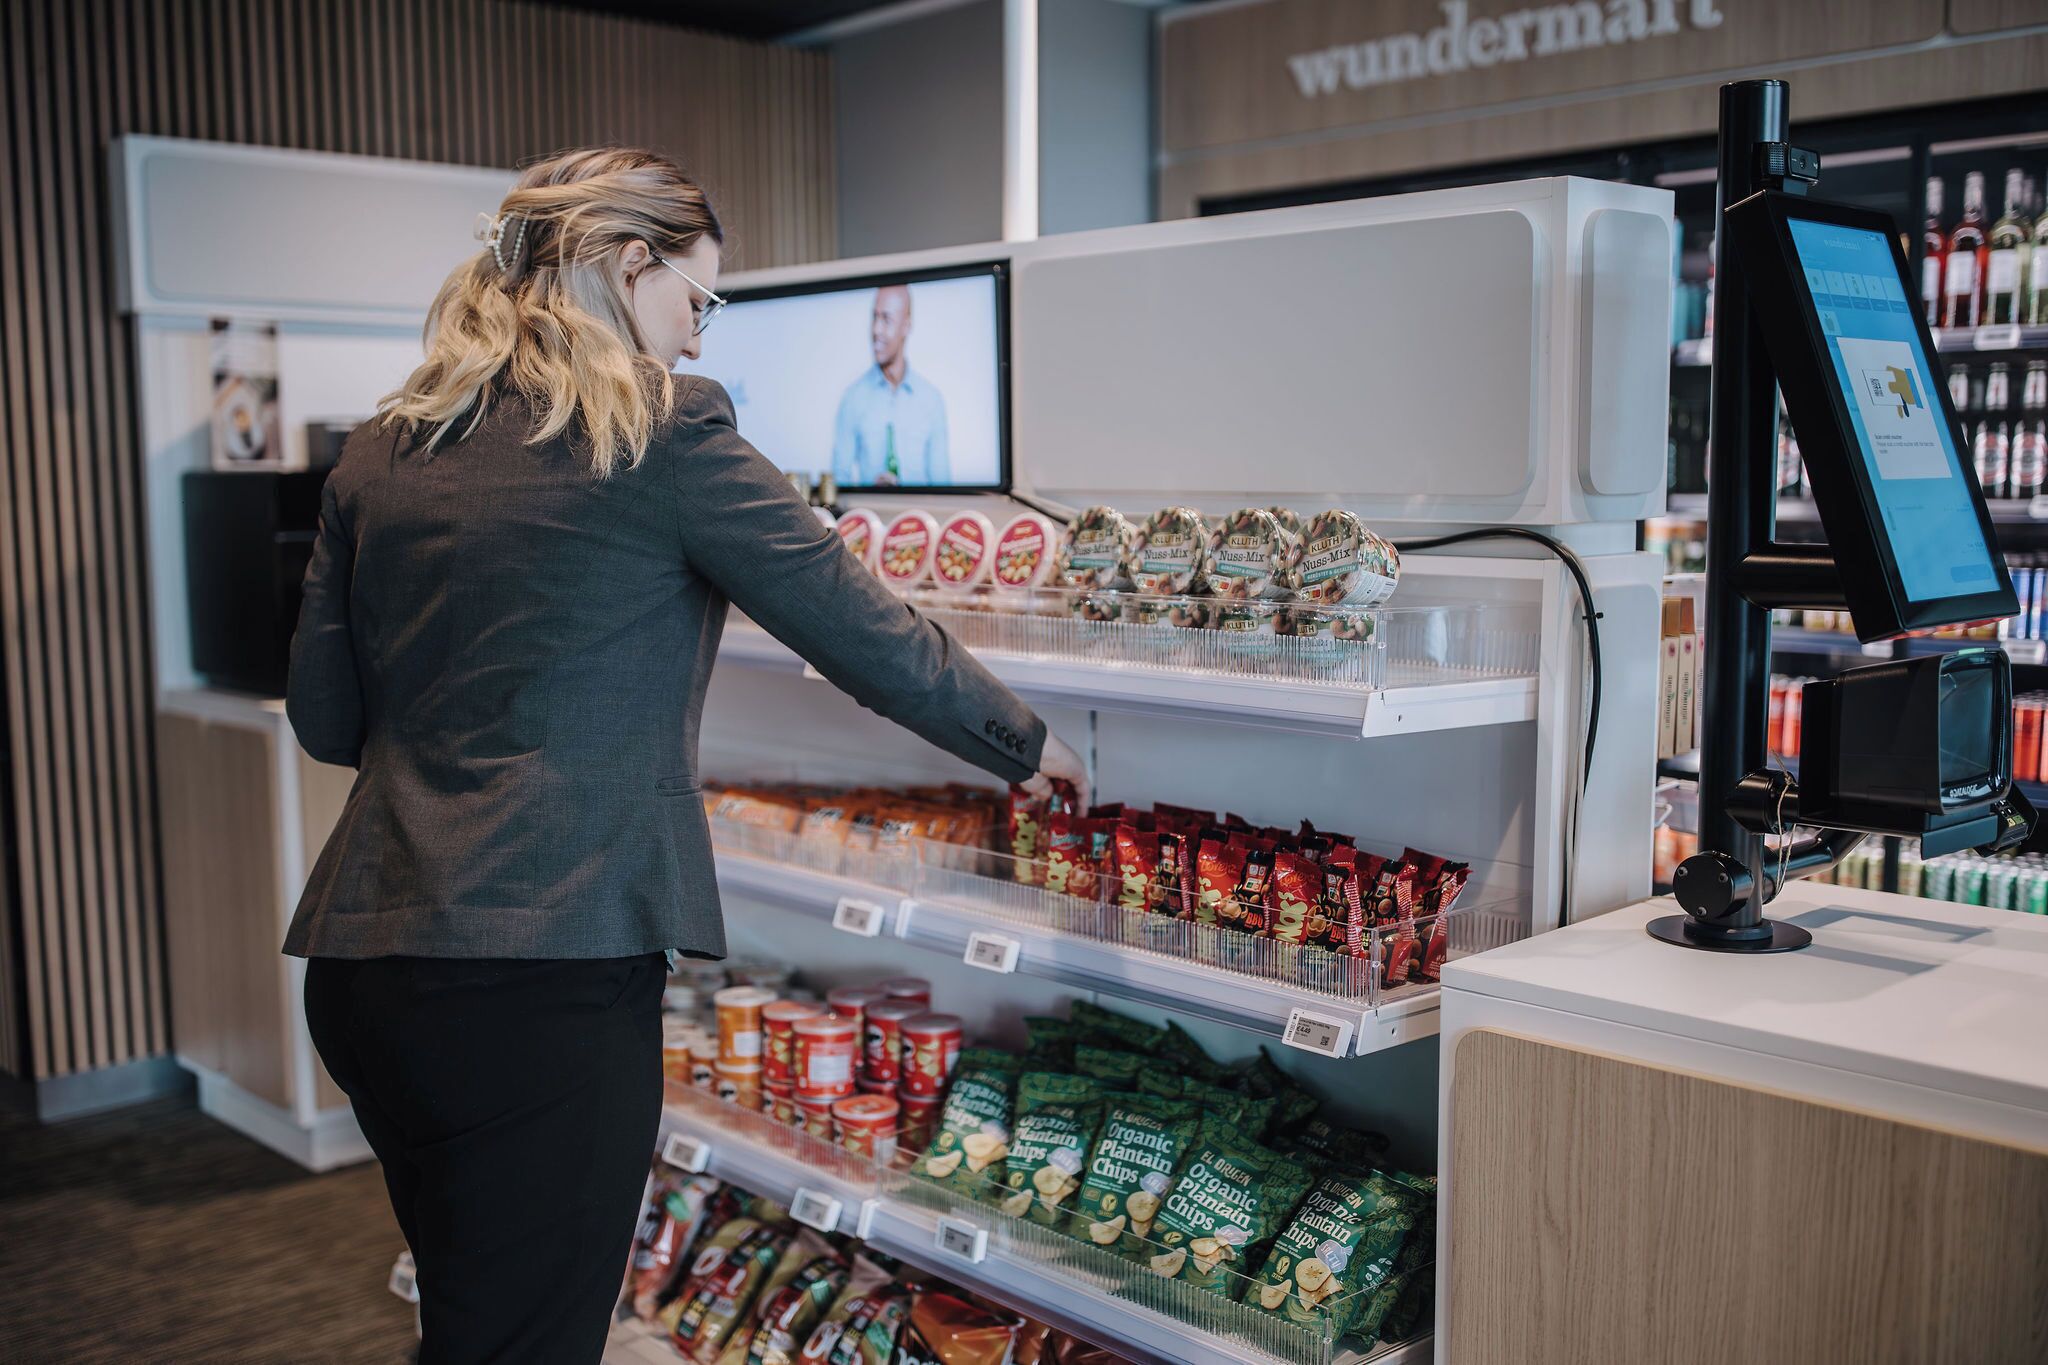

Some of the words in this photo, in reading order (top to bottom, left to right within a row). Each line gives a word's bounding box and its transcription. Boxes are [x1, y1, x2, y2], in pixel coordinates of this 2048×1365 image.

[1286, 0, 1724, 98] wundermart
[1154, 535, 1182, 545] KLUTH
[1230, 536, 1259, 547] KLUTH
[1311, 535, 1340, 553] KLUTH
[1144, 549, 1190, 560] Nuss-Mix
[1218, 550, 1265, 563] Nuss-Mix
[1302, 548, 1351, 573] Nuss-Mix
[1225, 620, 1256, 630] KLUTH
[1245, 912, 1264, 929] BBQ
[1331, 925, 1347, 943] BBQ
[944, 1106, 983, 1128] hips
[1019, 1115, 1081, 1132] Organic
[1112, 1109, 1124, 1120] EL
[1107, 1122, 1174, 1154] Organic
[1007, 1140, 1048, 1163] hips
[1098, 1139, 1173, 1175] Plantain
[1092, 1157, 1139, 1185] Chips
[1200, 1150, 1216, 1166] EL
[1213, 1157, 1253, 1187] ORIGEN
[1189, 1163, 1258, 1212] Organic
[1320, 1178, 1333, 1191] EL
[1331, 1182, 1365, 1210] ORIGEN
[1166, 1194, 1216, 1231] Chips
[1176, 1176, 1251, 1230] Plantain
[1307, 1191, 1362, 1225] Organic
[1282, 1220, 1319, 1249] hips
